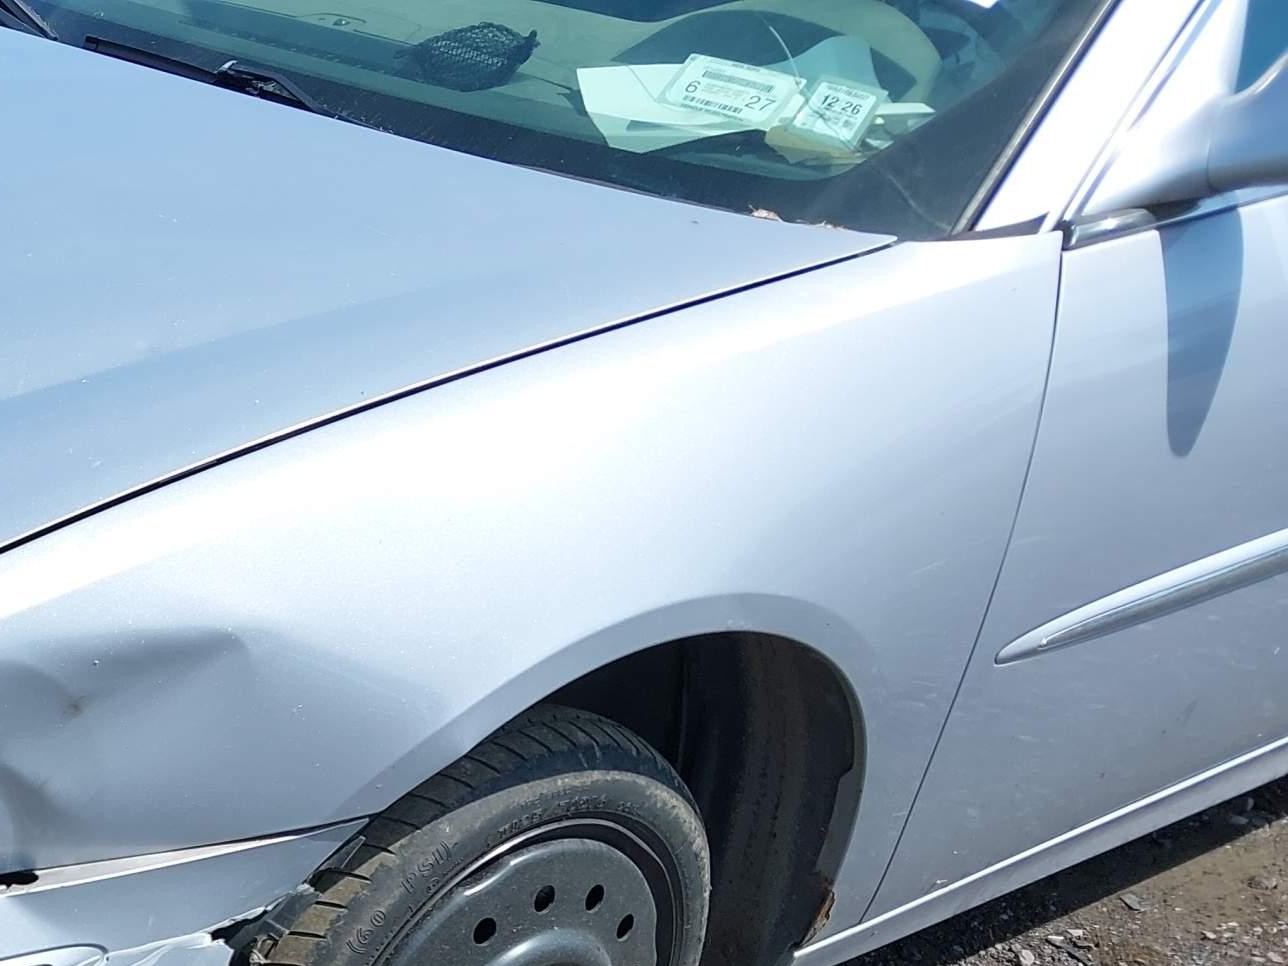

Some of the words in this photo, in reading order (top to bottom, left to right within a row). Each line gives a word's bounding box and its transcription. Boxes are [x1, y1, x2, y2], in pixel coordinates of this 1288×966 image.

[685, 80, 701, 93] 6
[744, 95, 776, 112] 27
[820, 94, 839, 108] 12
[841, 101, 863, 116] 26
[346, 909, 386, 954] (60
[400, 840, 452, 894] PSI)
